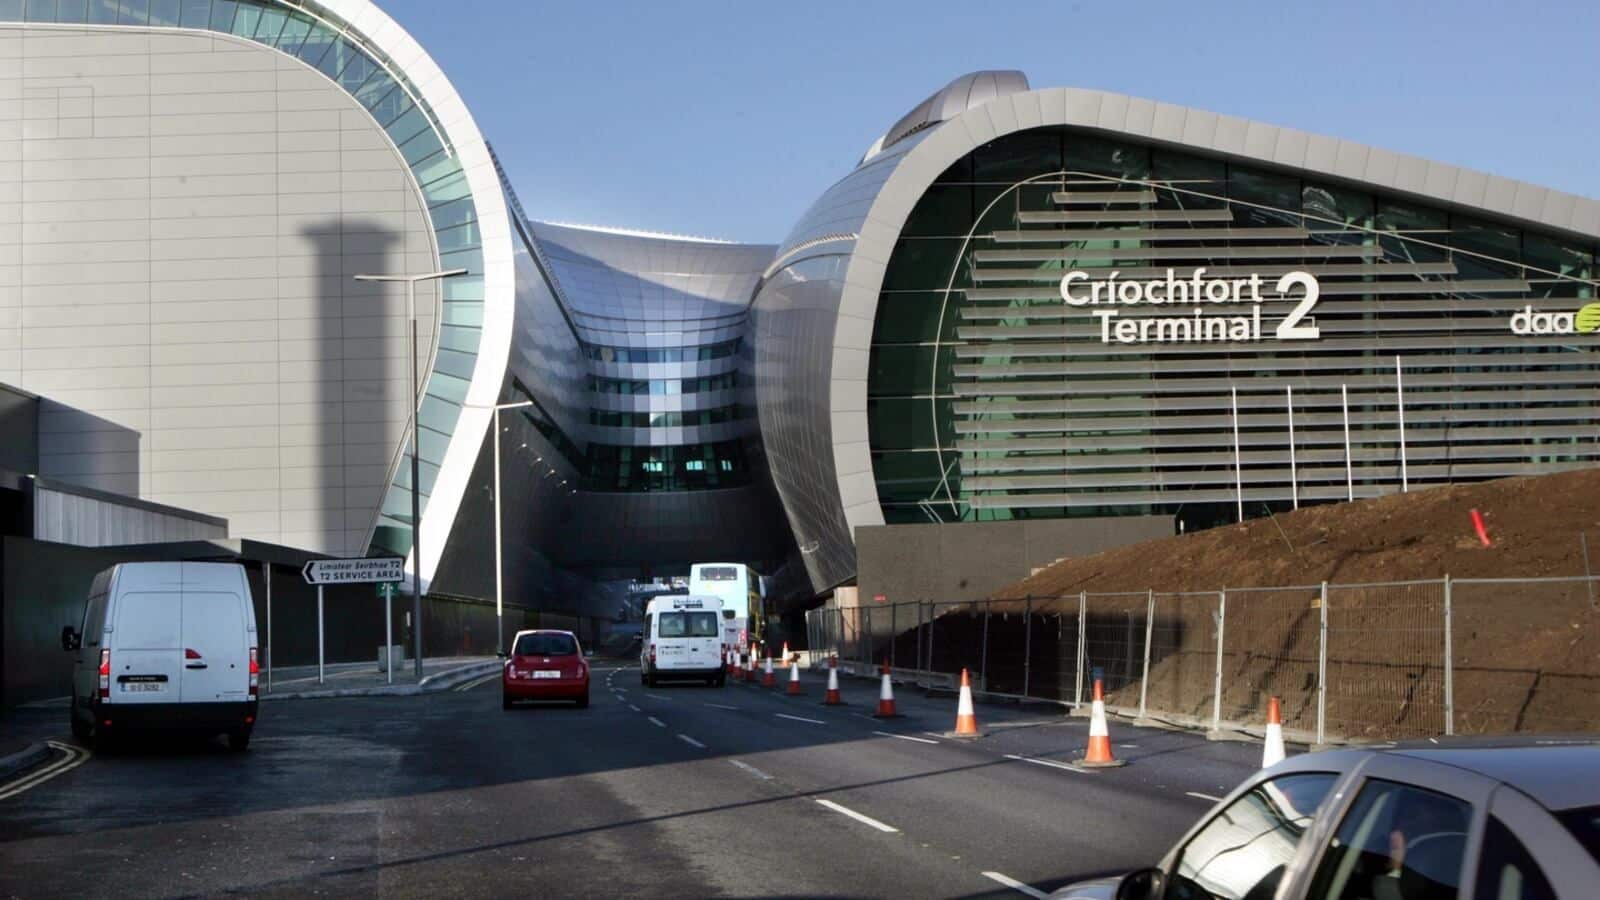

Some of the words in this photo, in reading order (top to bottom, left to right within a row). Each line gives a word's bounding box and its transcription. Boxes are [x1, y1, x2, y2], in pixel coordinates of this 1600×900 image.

[1060, 268, 1263, 305] Críochfort
[1275, 271, 1320, 339] 2
[1092, 304, 1261, 342] Terminal
[1510, 305, 1574, 334] daa
[319, 572, 330, 581] T2
[334, 571, 372, 580] SERVICE
[376, 570, 401, 578] AREA
